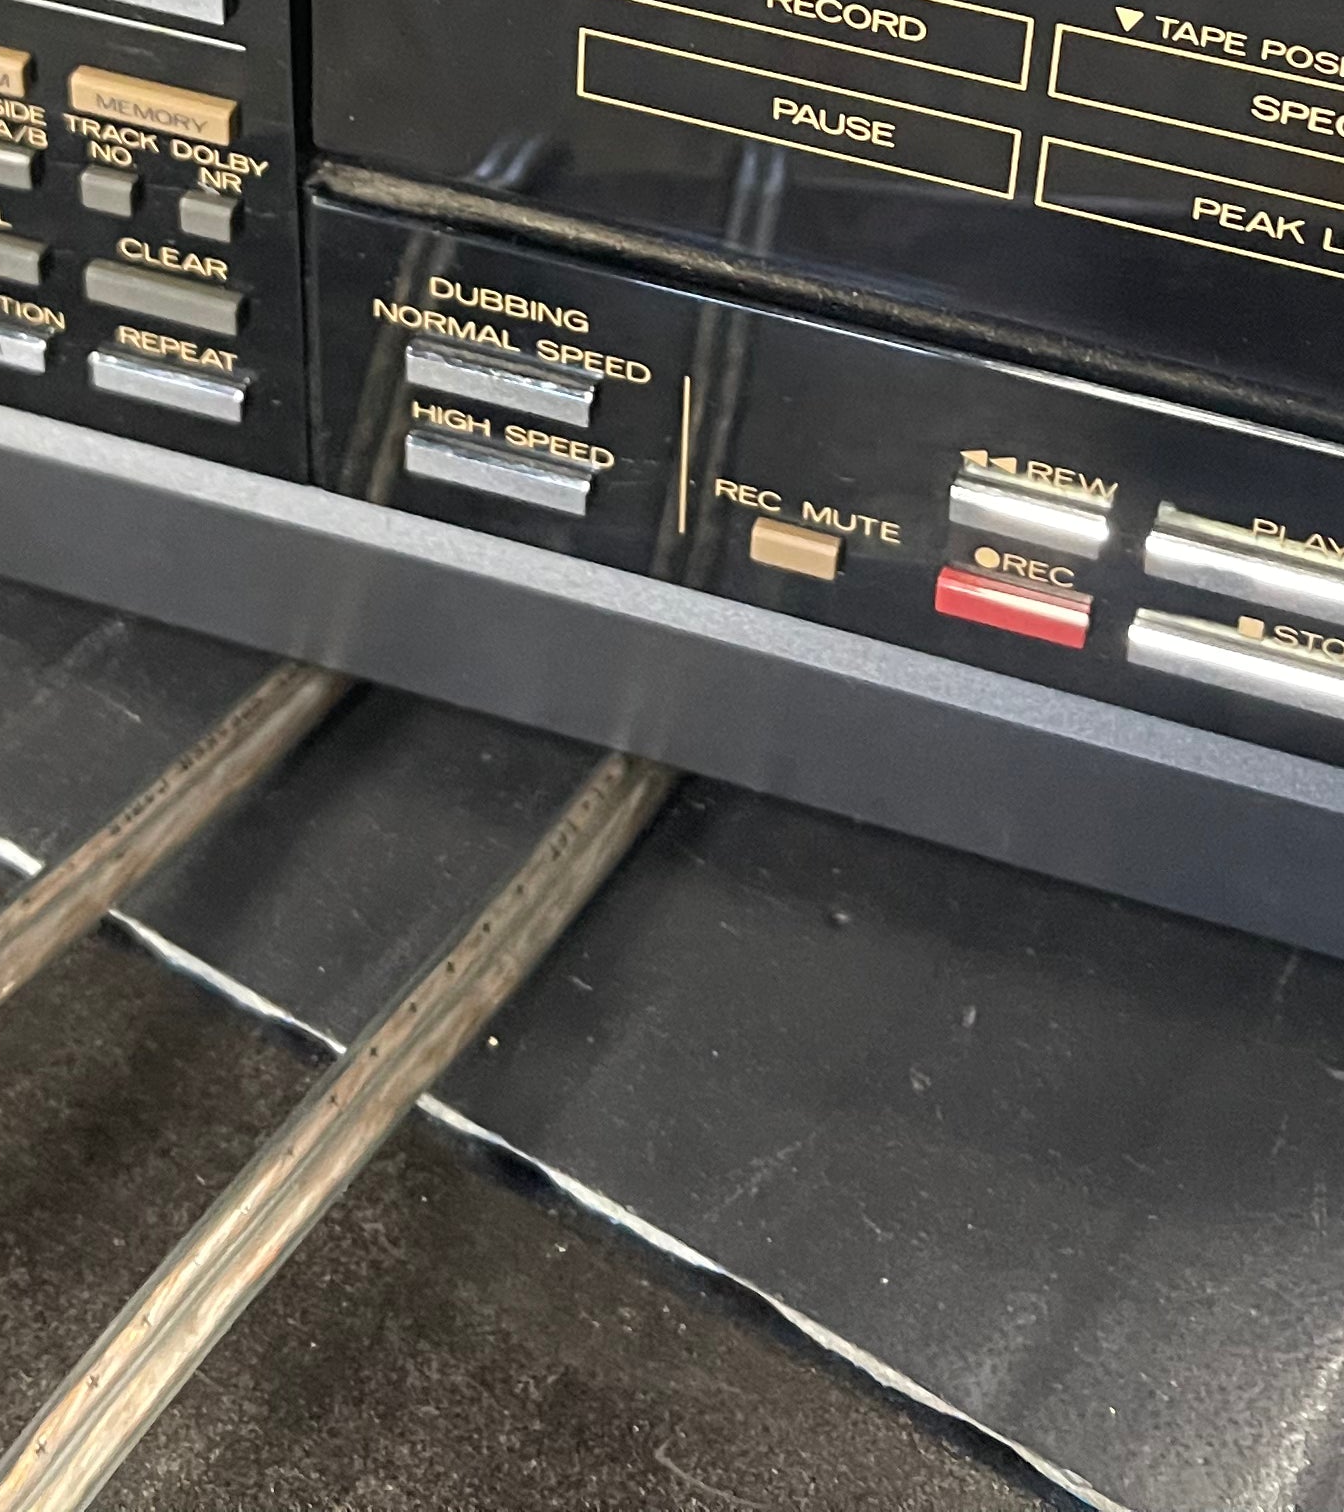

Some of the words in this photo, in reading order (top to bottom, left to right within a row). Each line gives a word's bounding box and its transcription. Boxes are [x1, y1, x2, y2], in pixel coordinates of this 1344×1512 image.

[1155, 15, 1249, 58] TAPE
[62, 112, 160, 154] TRACK
[94, 92, 210, 136] MEMORY
[772, 96, 897, 149] PAUSE
[168, 139, 269, 178] DOLBY
[197, 165, 242, 194] NR
[1191, 196, 1306, 246] PEAK
[116, 236, 230, 282] CLEAR
[429, 276, 590, 334] DUBBING
[115, 325, 240, 372] REPEAT
[372, 298, 521, 353] NORMAL
[536, 338, 653, 385] SPEED
[411, 400, 491, 438] HIGH
[504, 425, 616, 471] SPEED
[1027, 459, 1120, 500] REW
[714, 478, 783, 513] REC
[802, 500, 902, 545] MUTE
[1001, 554, 1076, 589] REC
